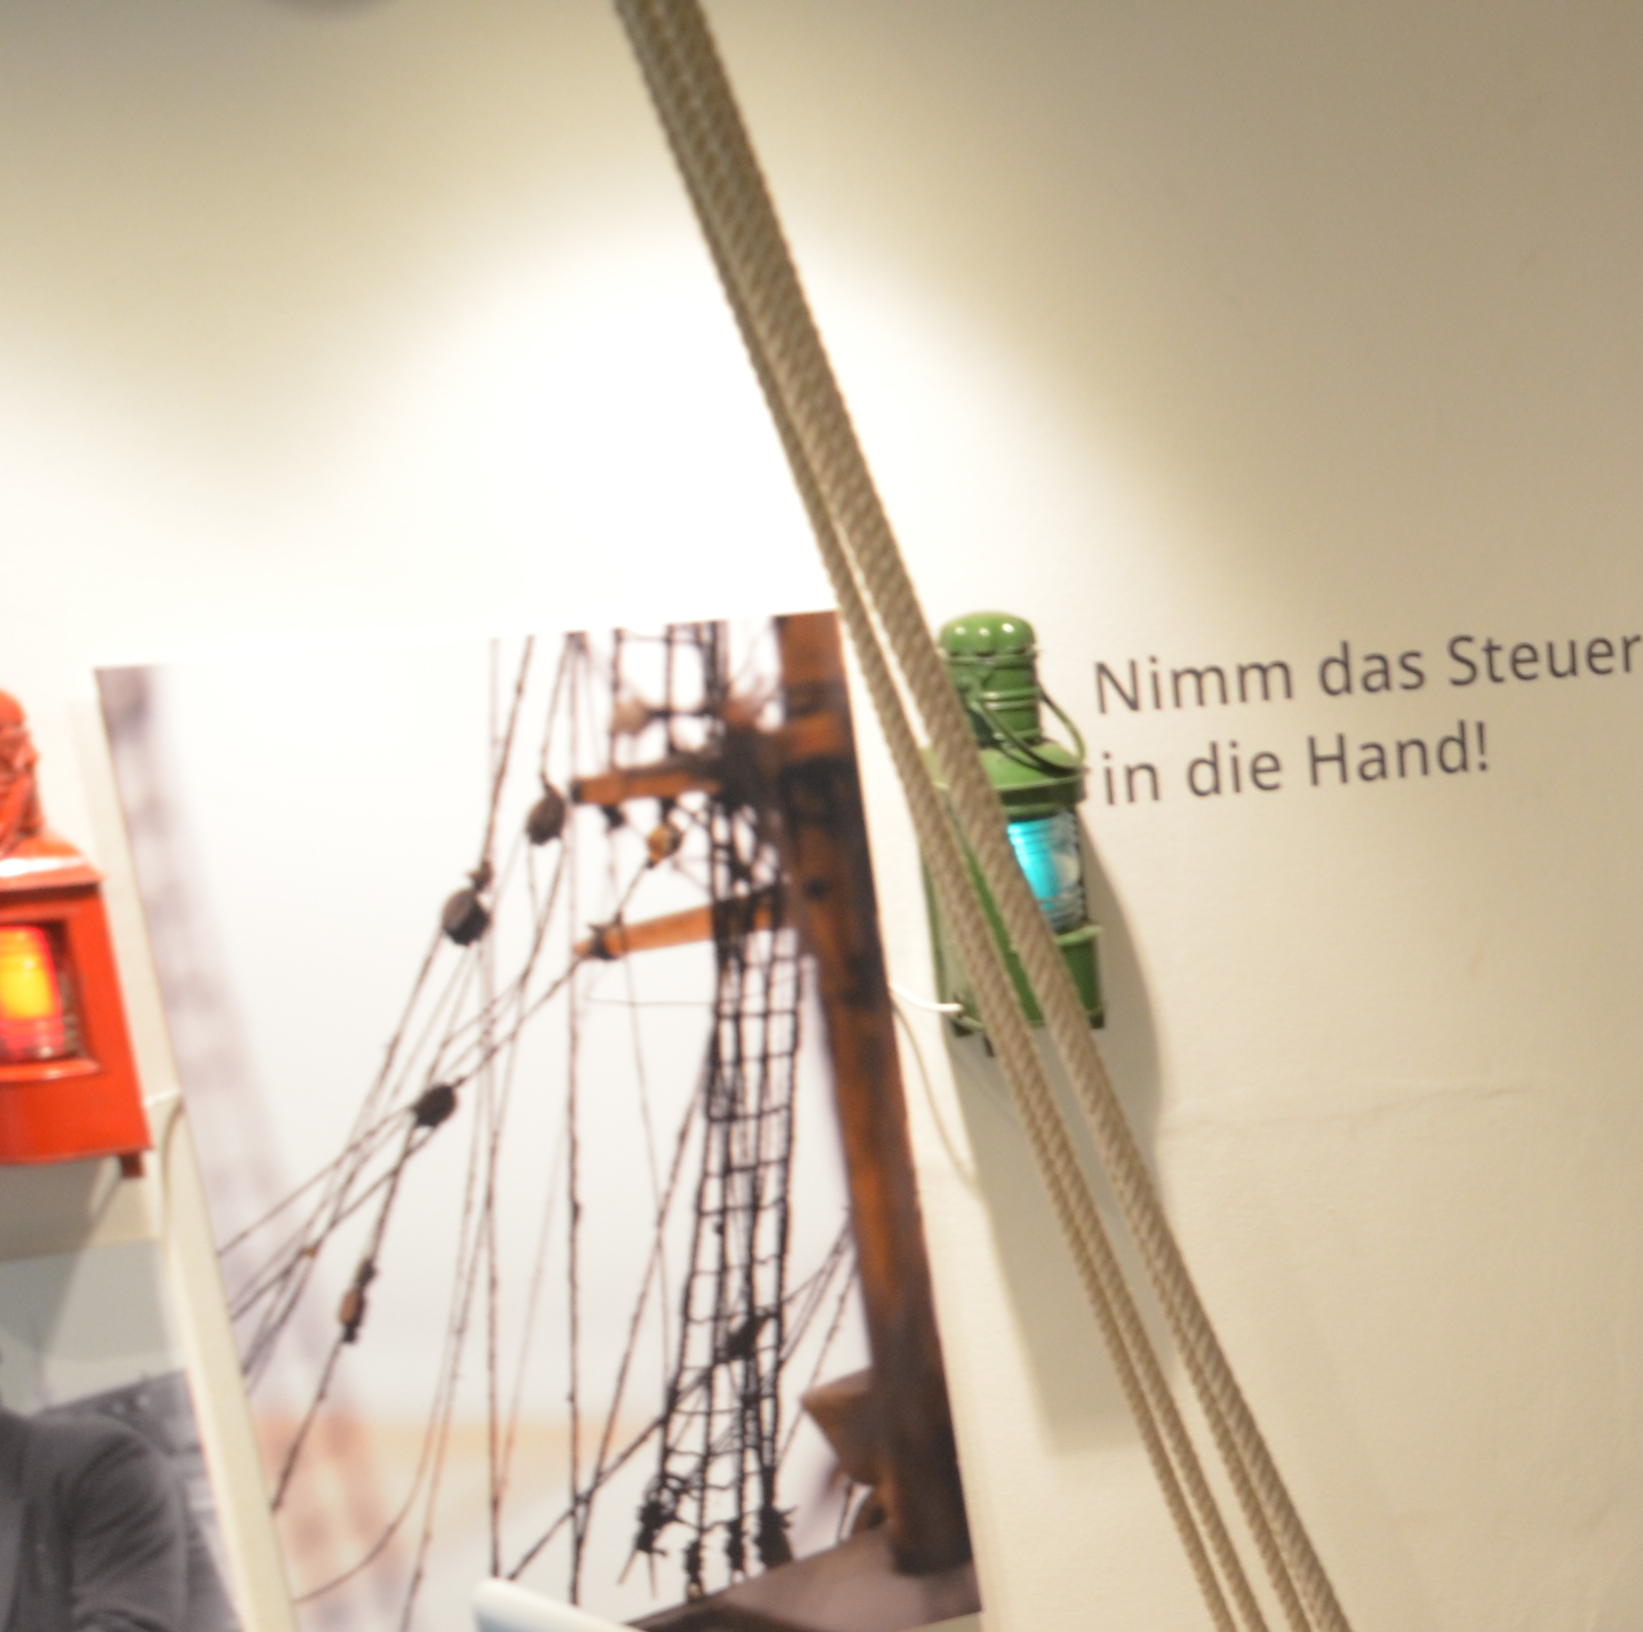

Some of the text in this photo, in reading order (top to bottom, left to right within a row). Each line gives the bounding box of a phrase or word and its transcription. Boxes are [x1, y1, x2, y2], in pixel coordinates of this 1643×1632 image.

[1094, 634, 1643, 715] Nimm das Steuer
[1102, 719, 1489, 806] in die Hand!
